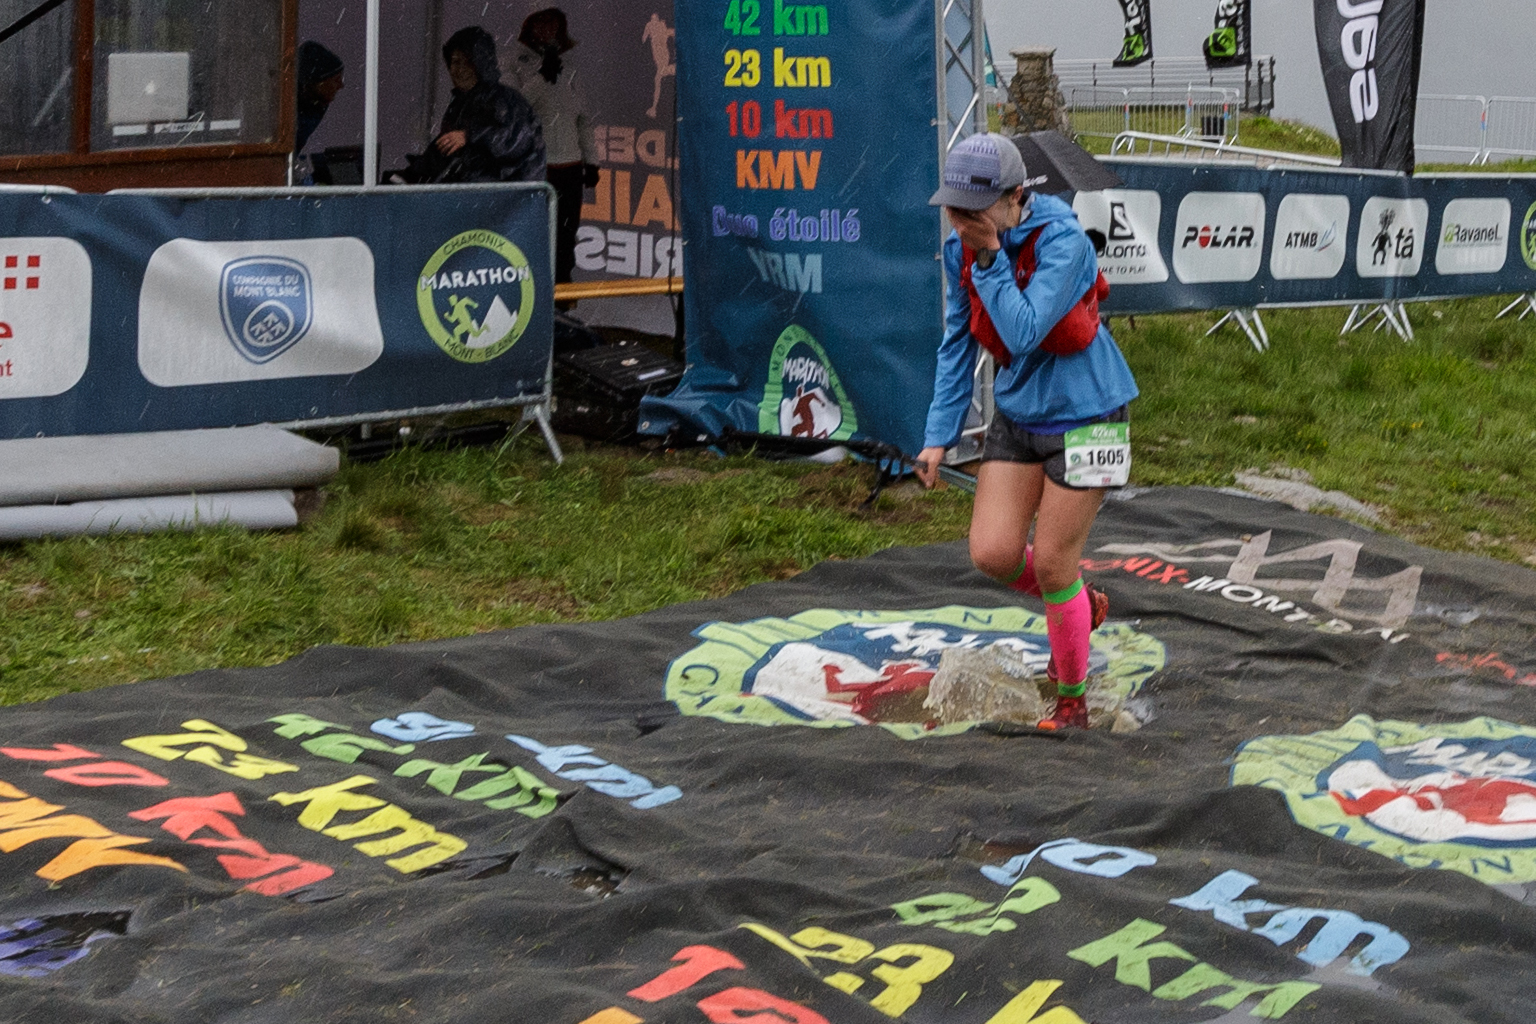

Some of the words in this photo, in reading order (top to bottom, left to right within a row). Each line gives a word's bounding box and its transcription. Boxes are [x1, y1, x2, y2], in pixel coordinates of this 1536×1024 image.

[724, 49, 761, 87] 23
[774, 47, 831, 88] km
[726, 100, 761, 138] 10
[775, 99, 833, 139] km
[736, 150, 822, 190] KMV
[713, 205, 759, 238] Duo
[769, 206, 861, 242] étoilé
[1182, 226, 1255, 249] POLAR
[1285, 231, 1318, 248] ATMB
[443, 232, 505, 256] CHAMONIX
[420, 264, 530, 291] MARATHON
[748, 246, 822, 294] YRM
[1086, 448, 1124, 466] 1605
[267, 775, 468, 875] km
[1169, 869, 1412, 978] km
[1067, 918, 1322, 1019] km
